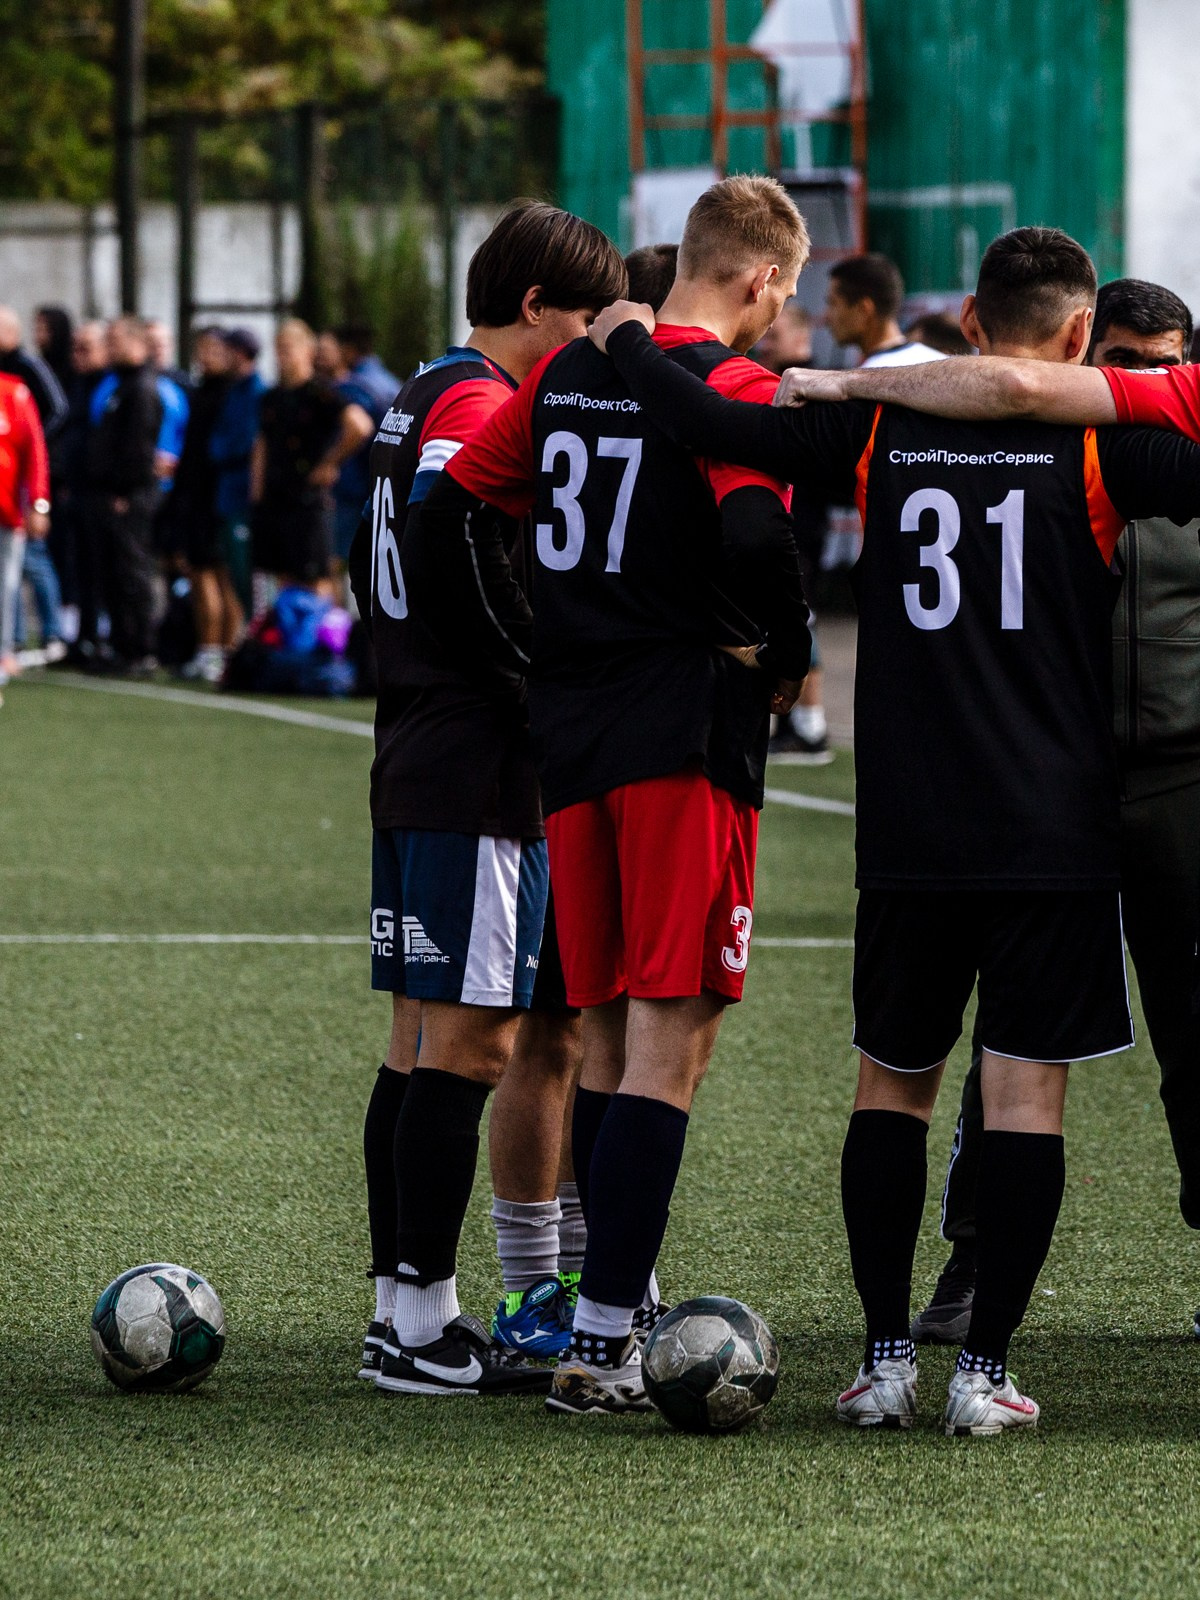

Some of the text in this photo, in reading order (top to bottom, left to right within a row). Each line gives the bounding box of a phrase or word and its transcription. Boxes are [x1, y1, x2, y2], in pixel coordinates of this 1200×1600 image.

[543, 392, 642, 414] СтройПроектСер
[888, 449, 1054, 466] СтройПроектСервис
[536, 430, 643, 573] 37
[371, 476, 408, 620] 16
[900, 487, 1025, 631] 31
[370, 940, 394, 957] TIC
[371, 907, 394, 940] G
[721, 905, 753, 973] 3
